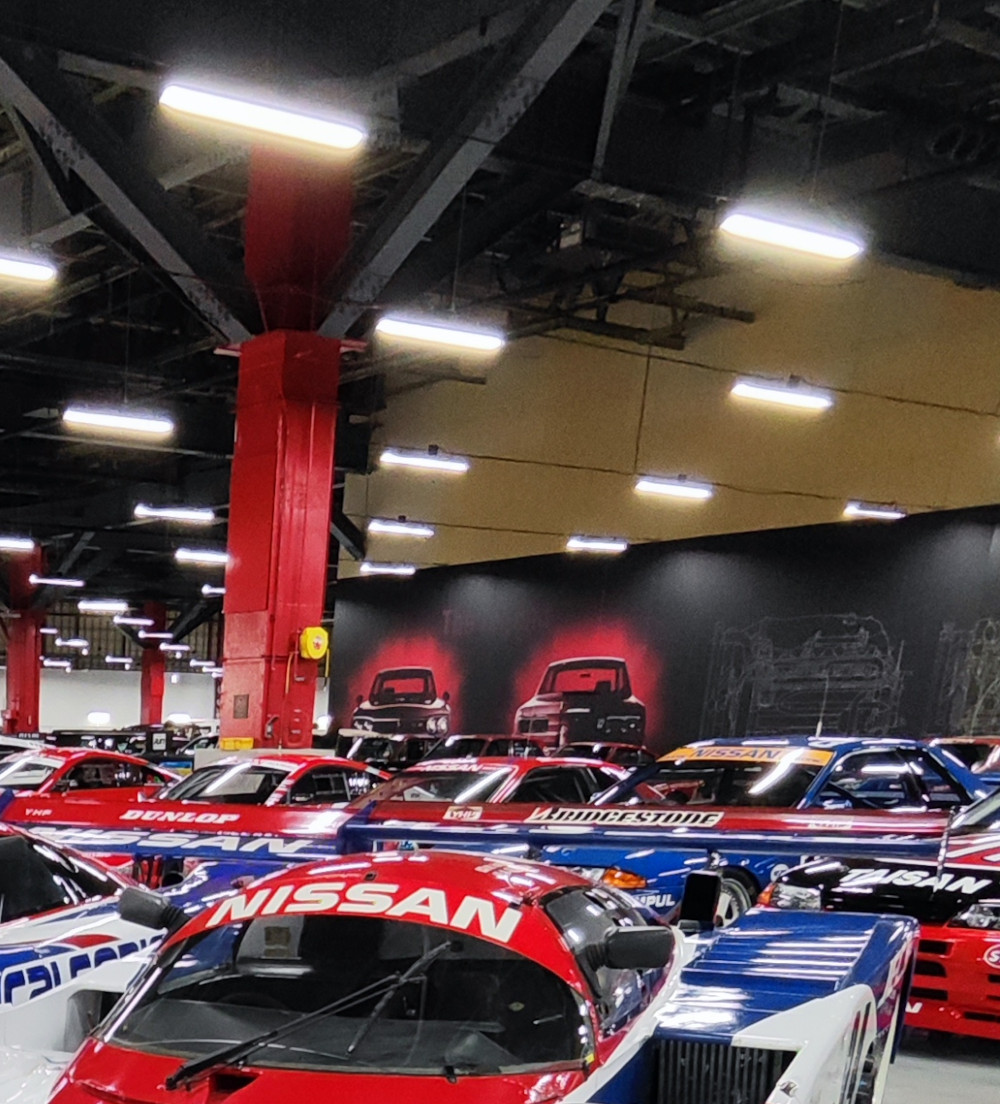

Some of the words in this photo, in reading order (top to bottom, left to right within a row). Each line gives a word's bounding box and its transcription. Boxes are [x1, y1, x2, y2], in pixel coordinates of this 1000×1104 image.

[119, 810, 241, 824] DUNLOP
[535, 807, 721, 826] BRIDGESTONE
[839, 868, 993, 895] TAISAN
[634, 893, 676, 908] MPUL
[205, 882, 522, 943] NISSAN
